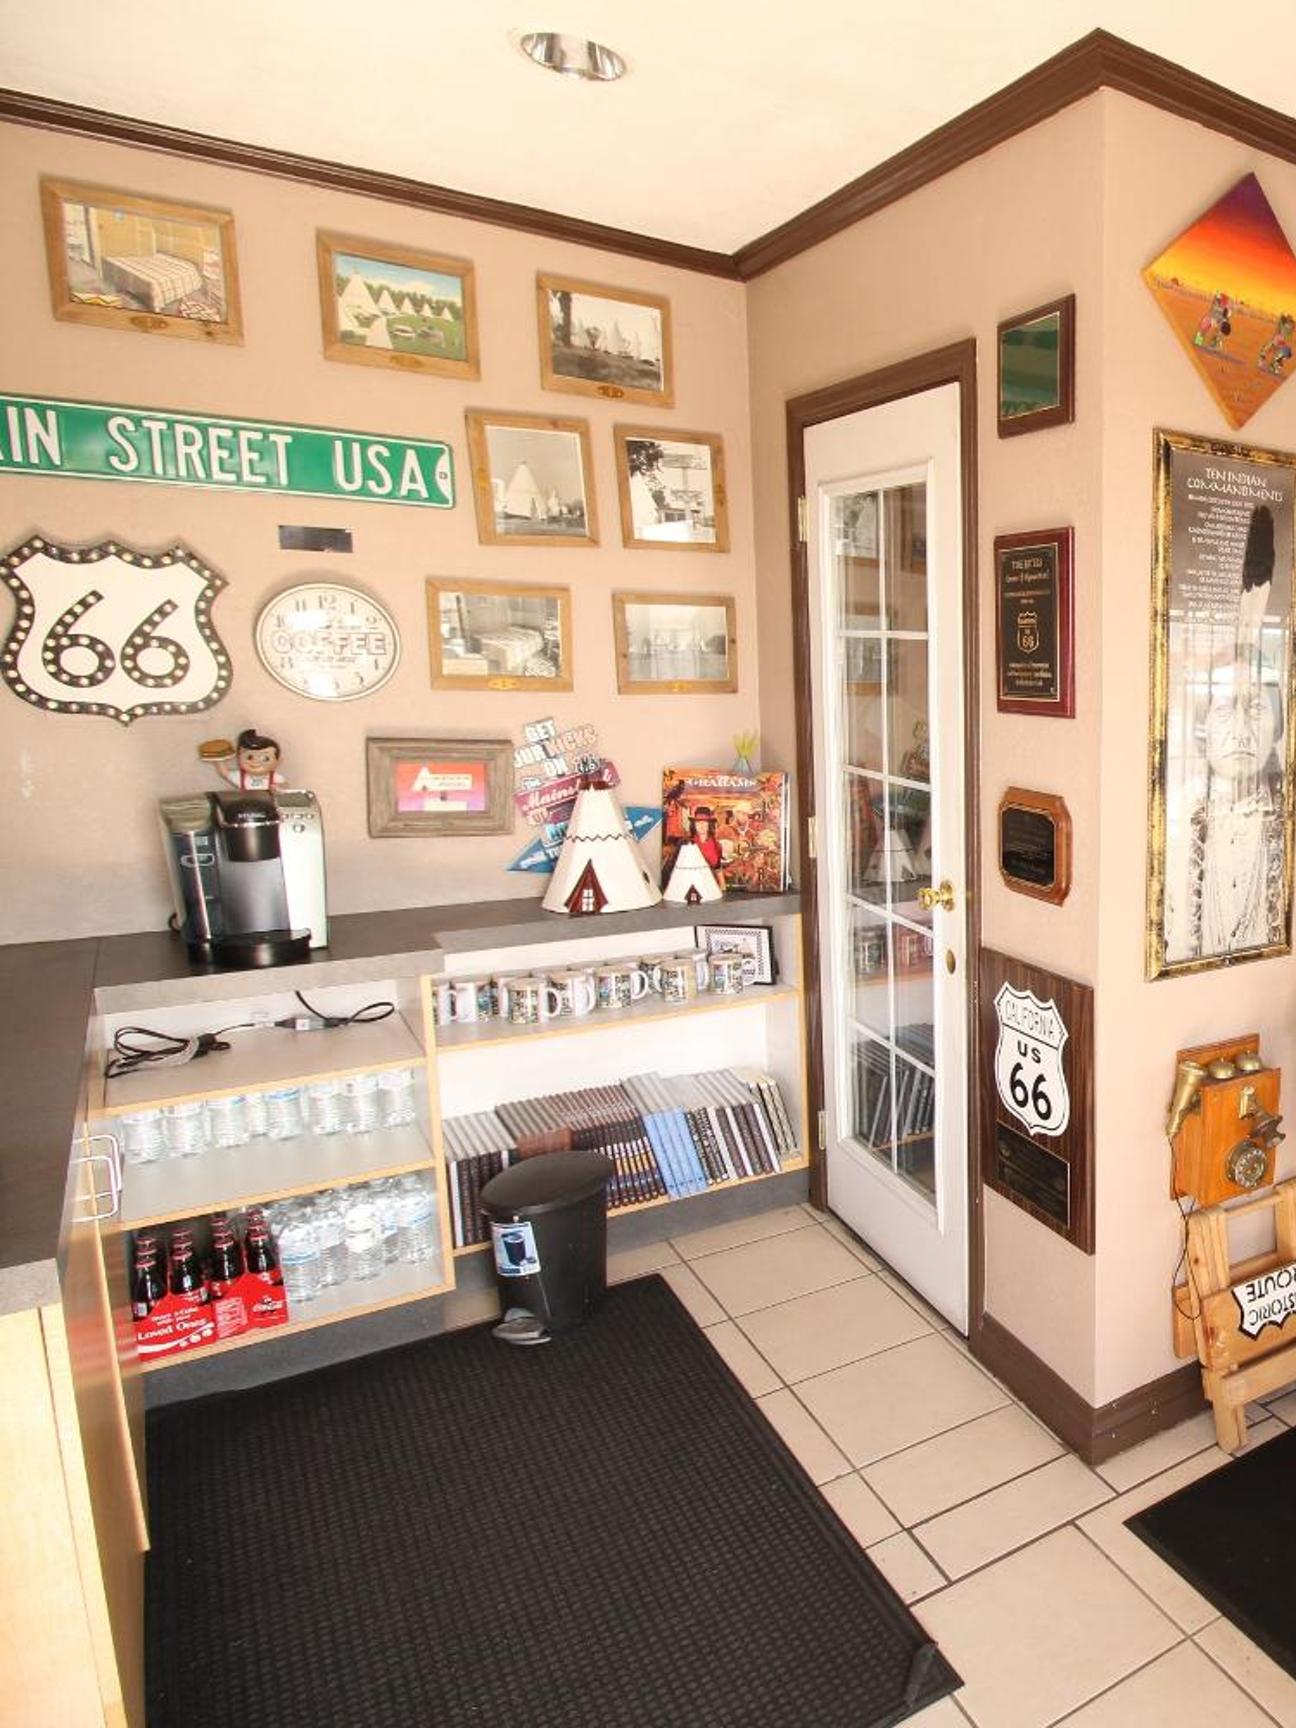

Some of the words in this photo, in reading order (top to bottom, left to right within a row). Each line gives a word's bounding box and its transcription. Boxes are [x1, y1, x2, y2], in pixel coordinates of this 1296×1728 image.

[0, 405, 62, 466] IN
[106, 415, 293, 487] STREET
[333, 439, 429, 499] USA
[1186, 477, 1283, 502] COMMANDMENTS
[1205, 467, 1227, 482] TEN
[1227, 470, 1268, 488] INDIAN
[41, 589, 191, 689] 66
[271, 632, 388, 655] COFFEE
[1004, 999, 1055, 1040] CALIFORNIA
[1016, 1039, 1042, 1064] US
[1009, 1061, 1052, 1121] 66
[137, 1324, 174, 1341] Loved
[175, 1318, 208, 1332] Ones
